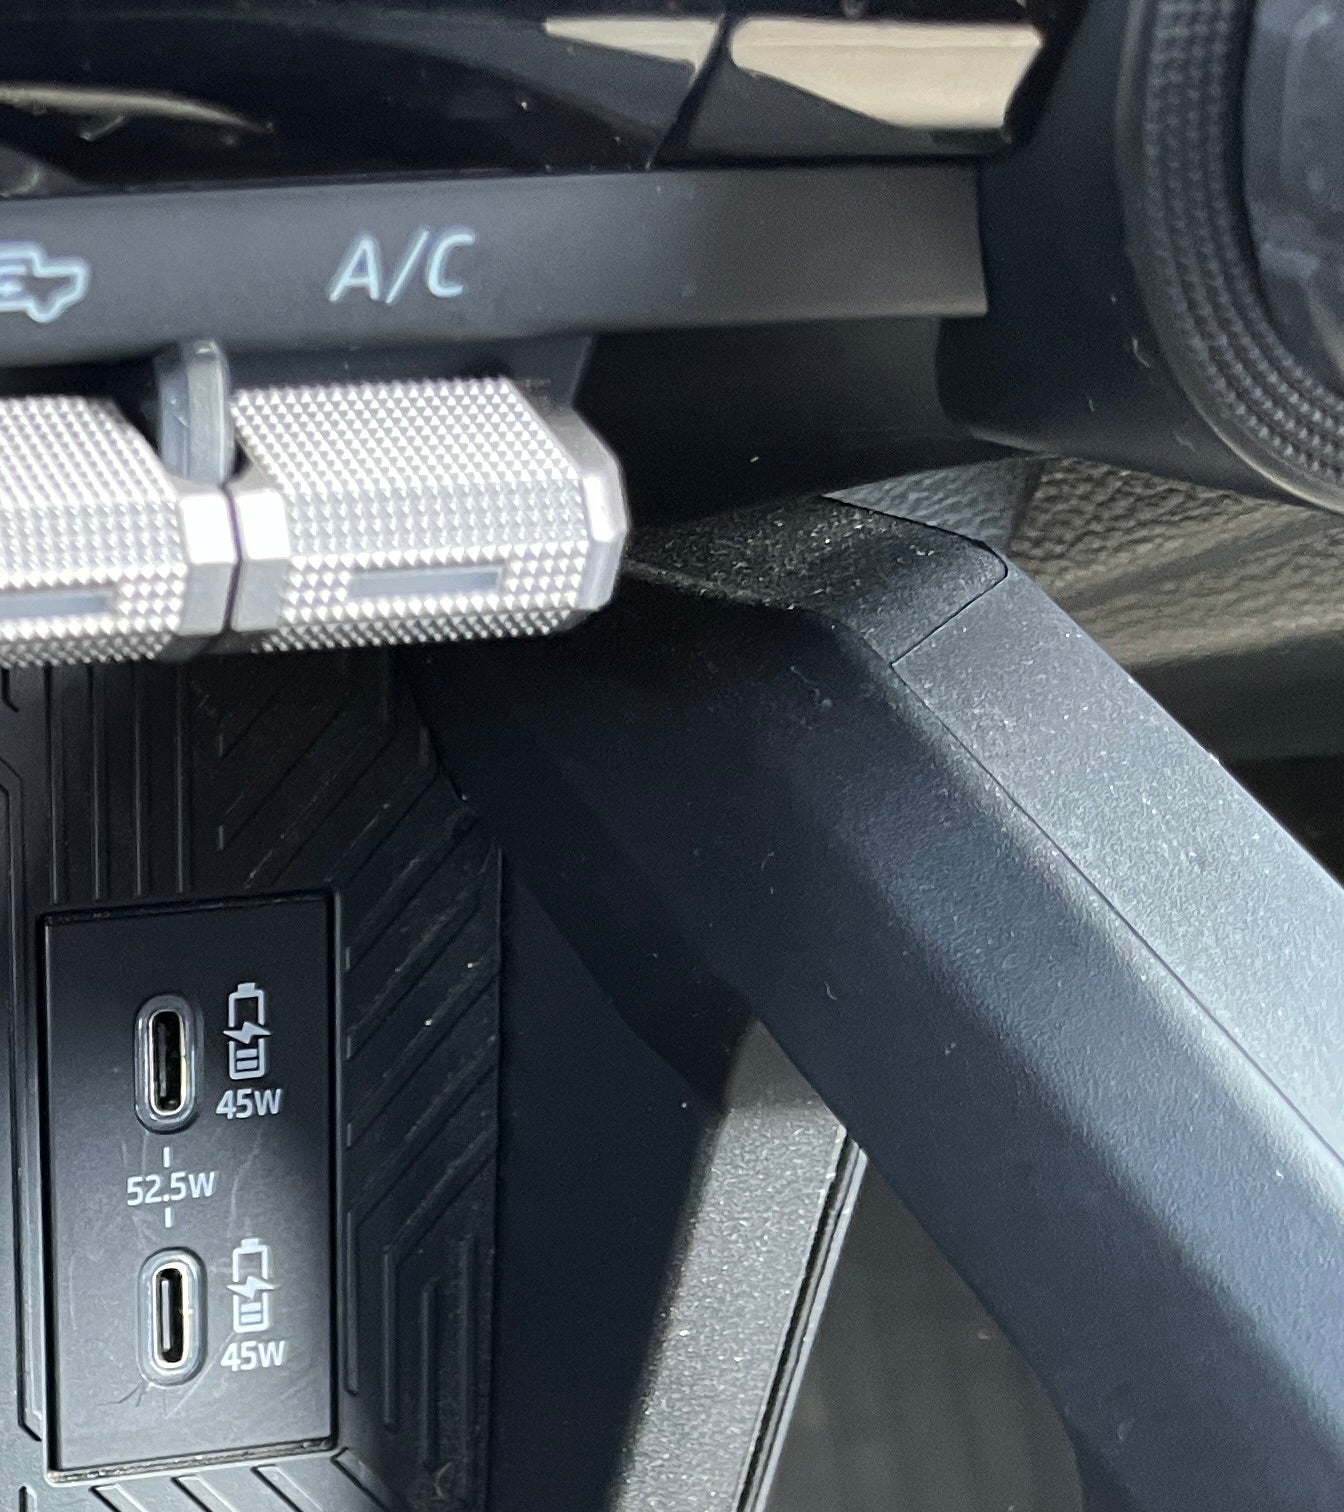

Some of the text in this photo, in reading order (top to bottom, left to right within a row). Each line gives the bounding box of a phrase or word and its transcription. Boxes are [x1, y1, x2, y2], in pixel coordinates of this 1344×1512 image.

[327, 224, 476, 304] A/C
[215, 1088, 282, 1120] 45W
[127, 1171, 216, 1206] 52.5W
[220, 1340, 286, 1372] 45W
